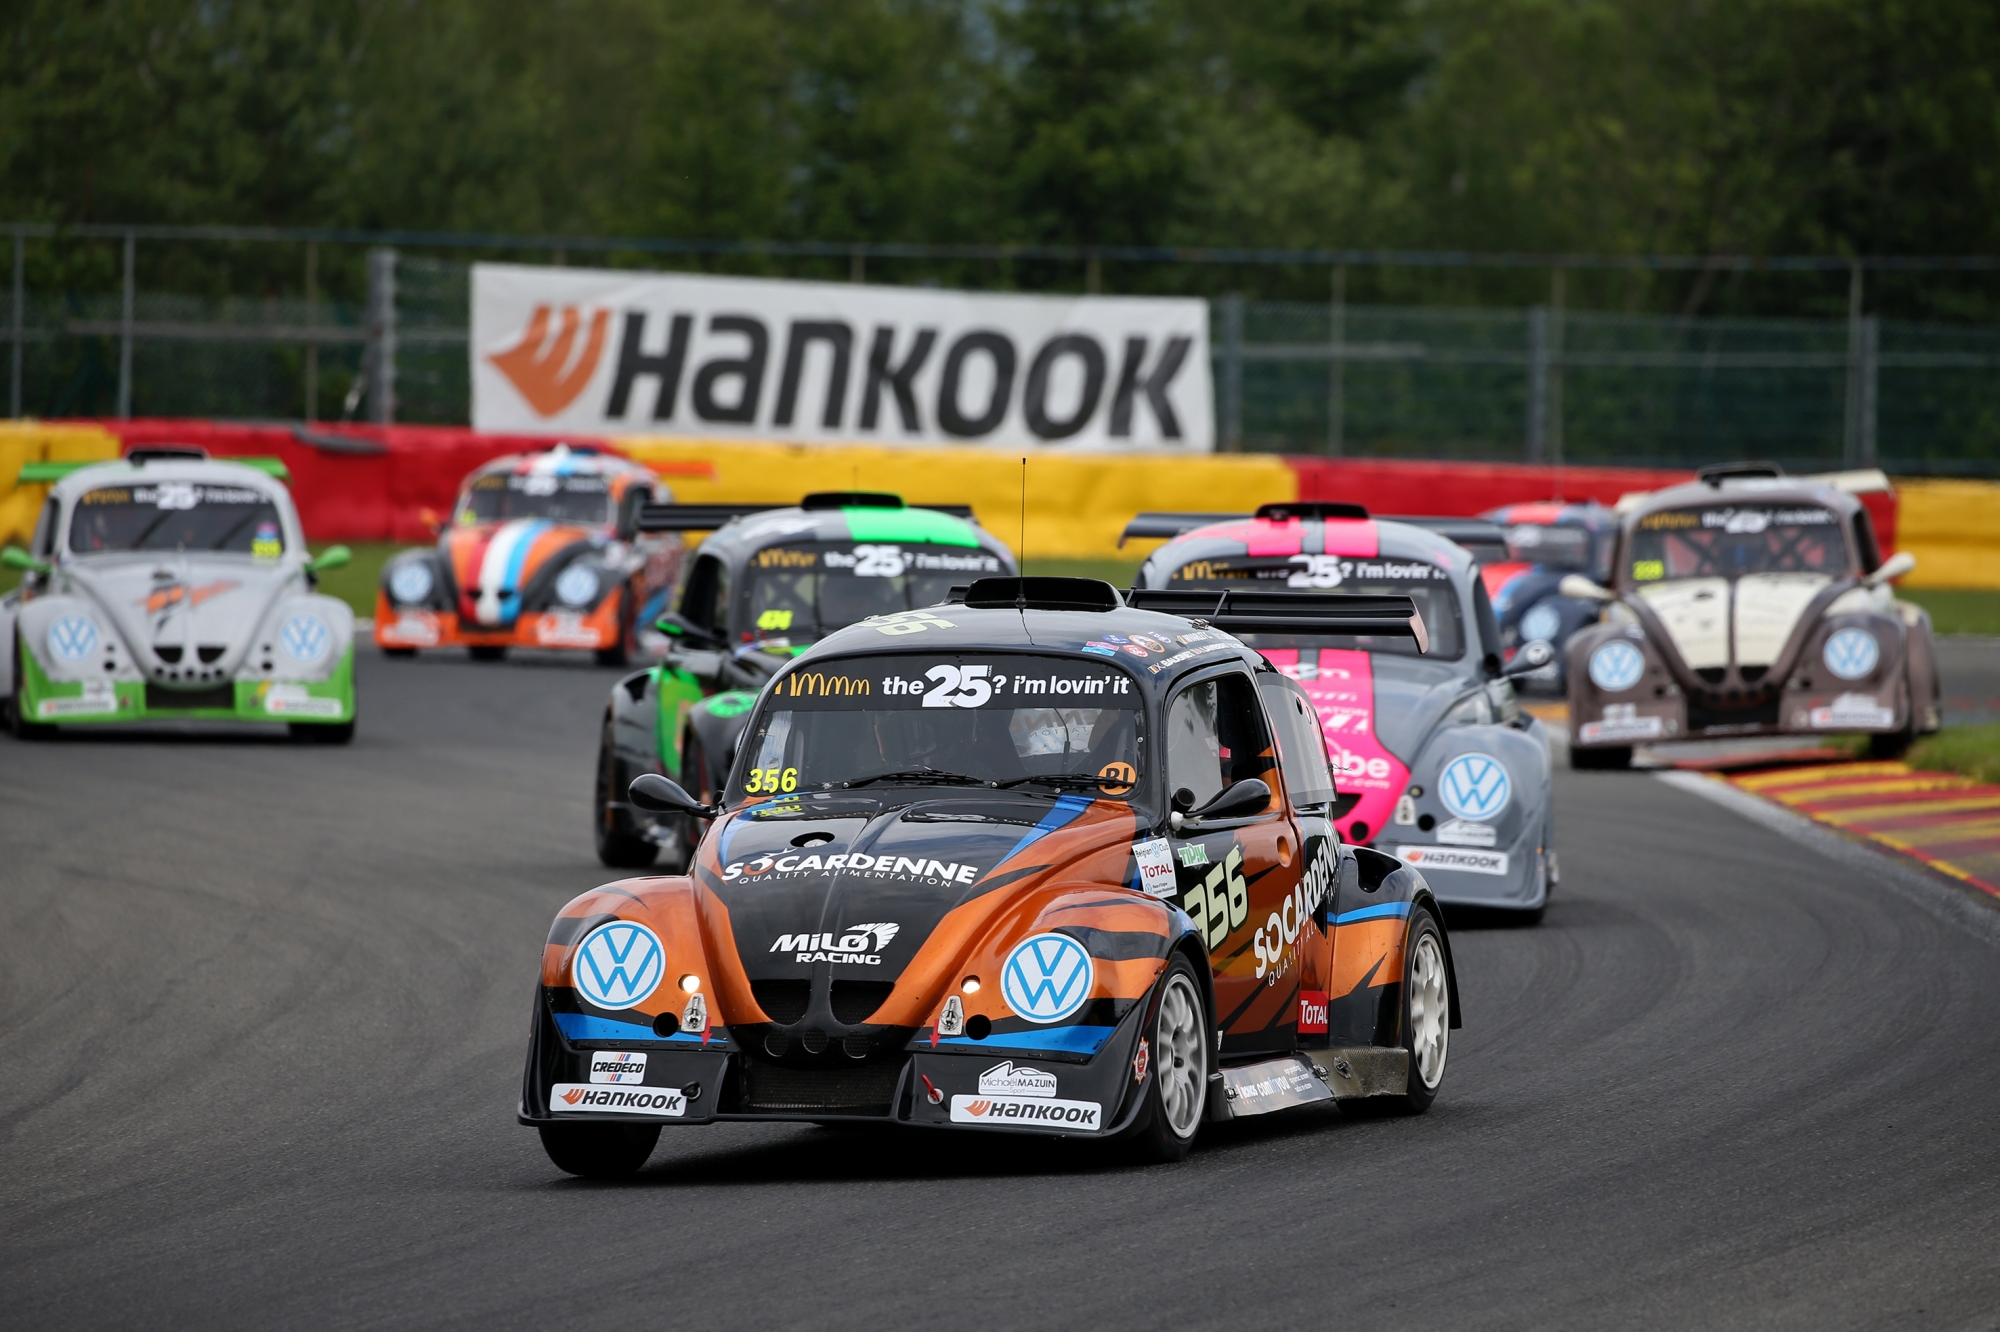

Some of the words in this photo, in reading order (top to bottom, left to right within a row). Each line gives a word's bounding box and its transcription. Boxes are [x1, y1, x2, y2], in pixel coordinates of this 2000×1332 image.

[882, 678, 925, 695] the
[1013, 676, 1047, 695] i'm
[1049, 675, 1110, 695] lovin'
[1113, 677, 1130, 695] it
[745, 767, 798, 793] 356
[721, 852, 979, 885] SOCARDENNE
[739, 870, 812, 885] QUALITY
[821, 868, 952, 888] ALIMENTATION
[1142, 863, 1173, 878] TOTAL
[1184, 844, 1248, 949] 356
[795, 952, 881, 965] RACING
[1301, 1000, 1328, 1024] TOTAL
[592, 1062, 645, 1074] CREDECO
